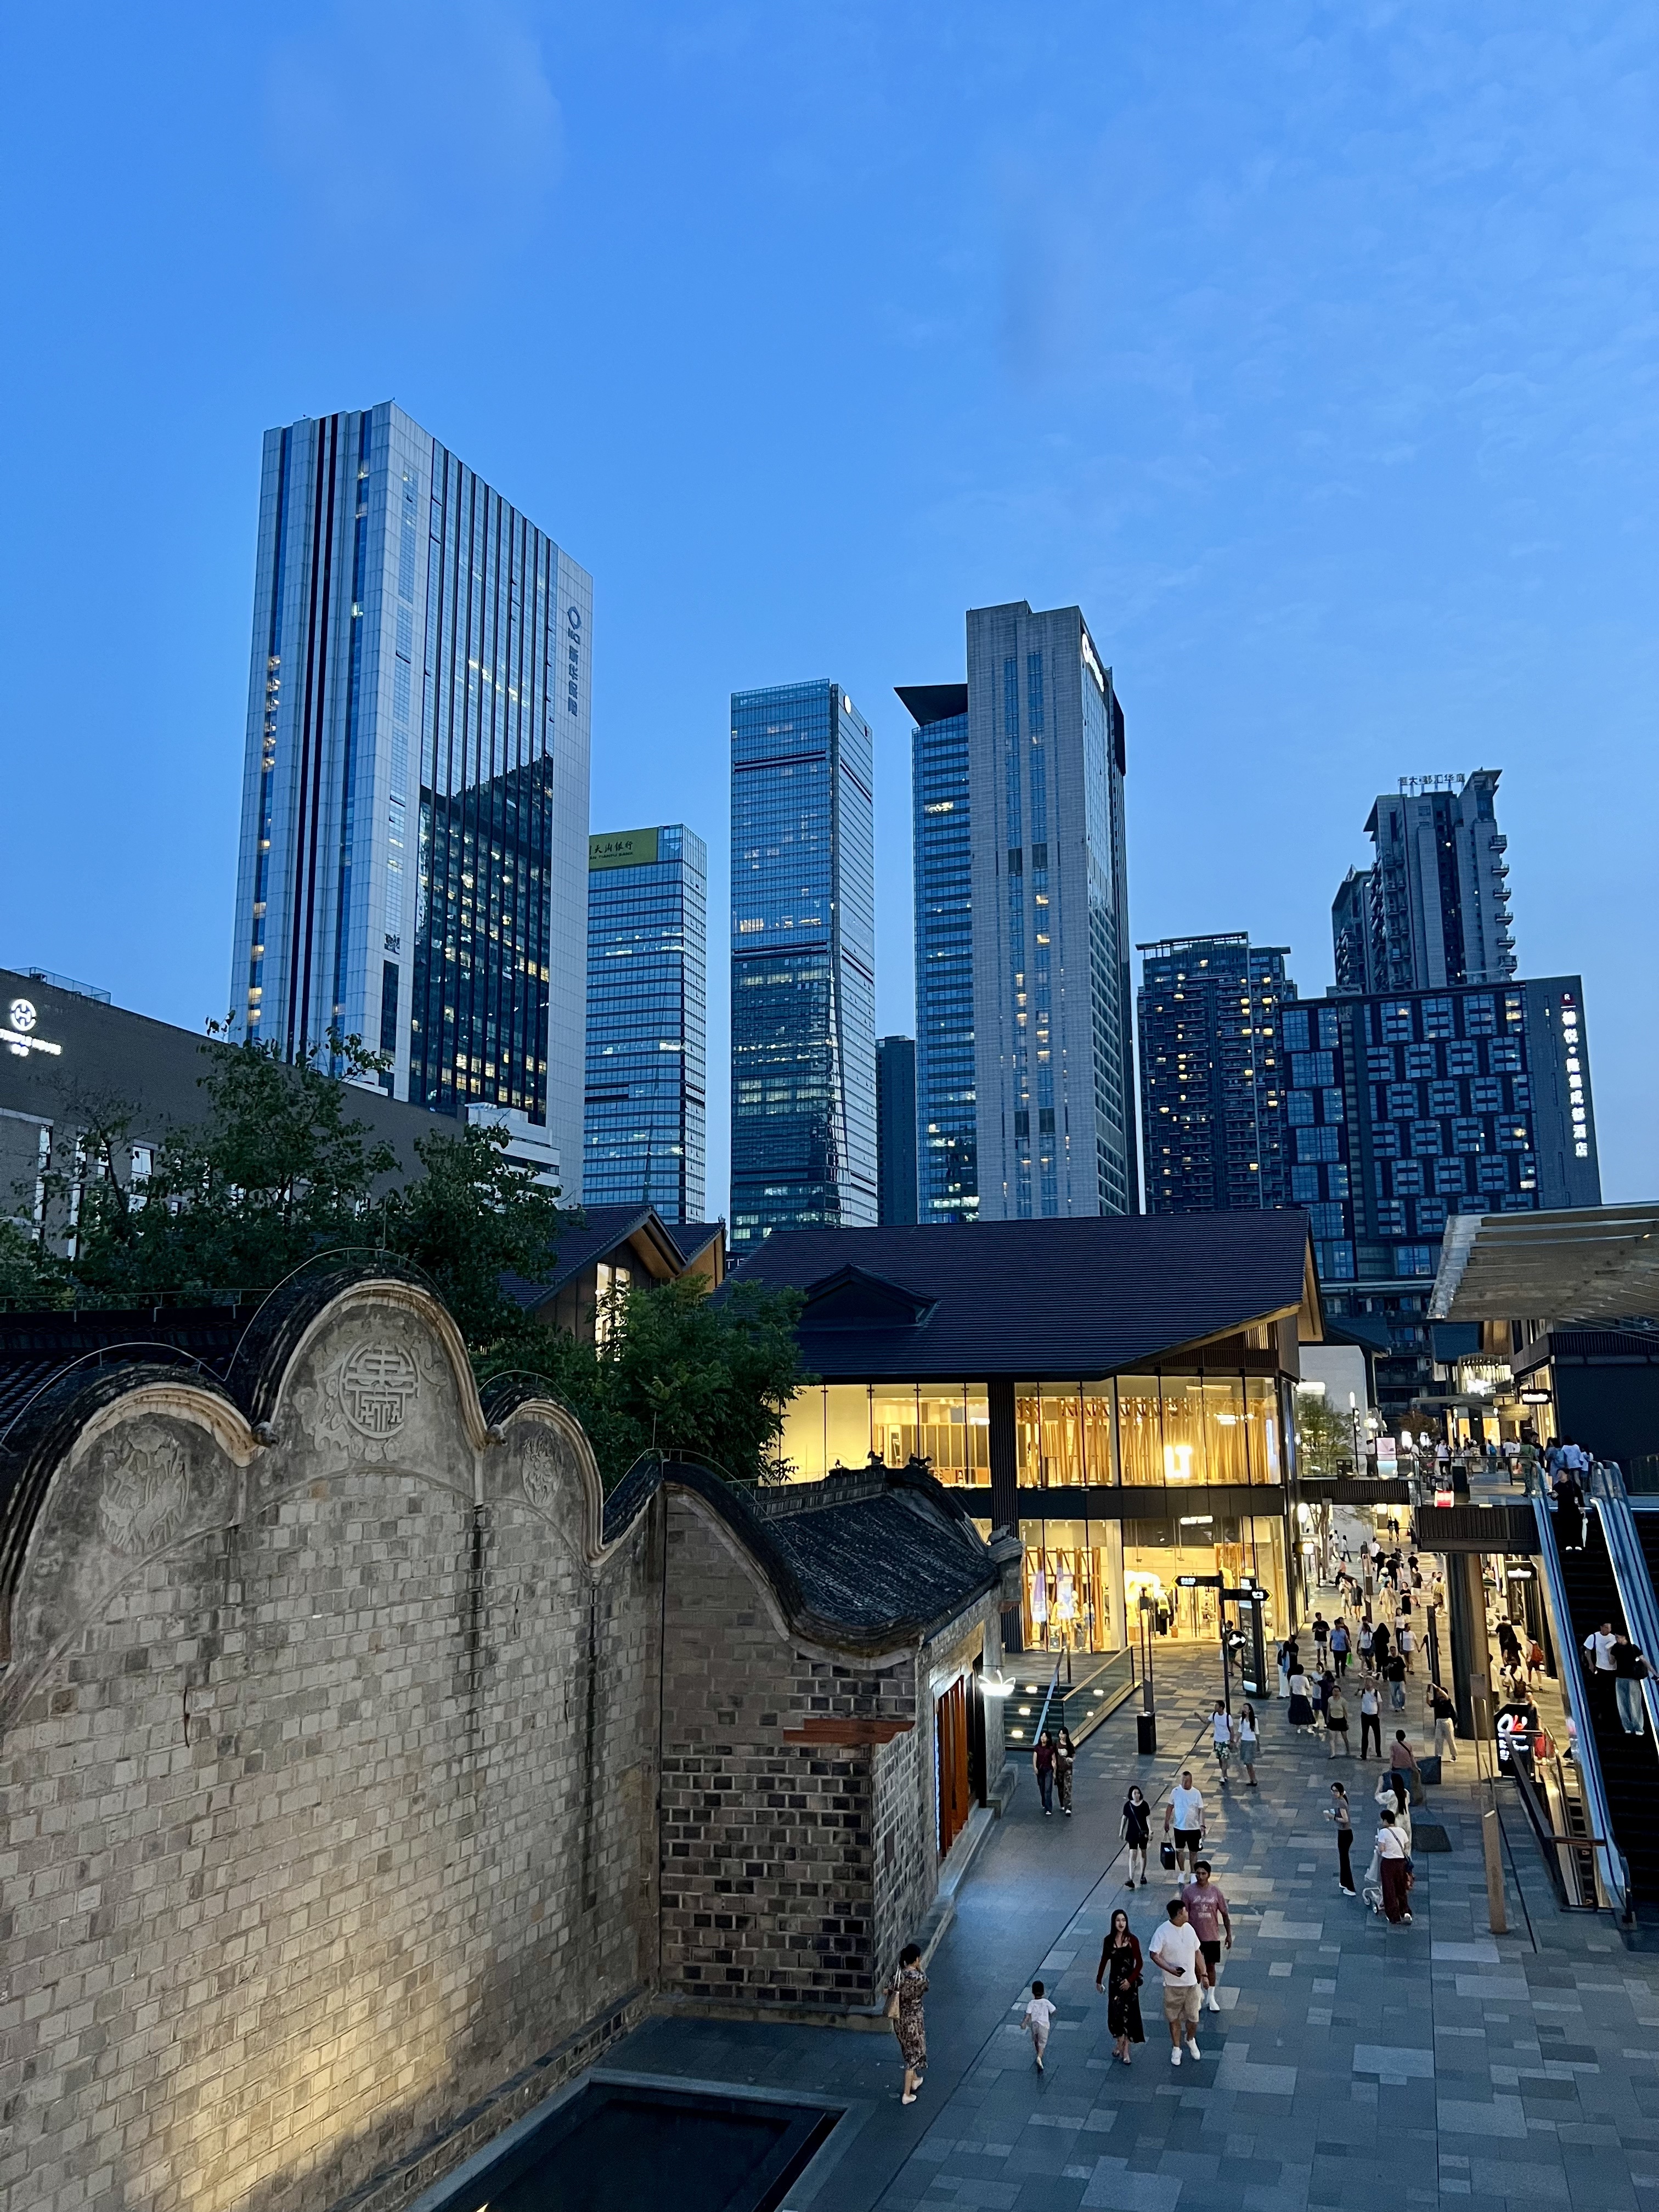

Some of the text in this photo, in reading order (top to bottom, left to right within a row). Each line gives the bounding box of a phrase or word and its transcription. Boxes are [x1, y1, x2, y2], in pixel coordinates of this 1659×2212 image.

[568, 645, 579, 717] 新华保险
[589, 840, 633, 855] 天府银行
